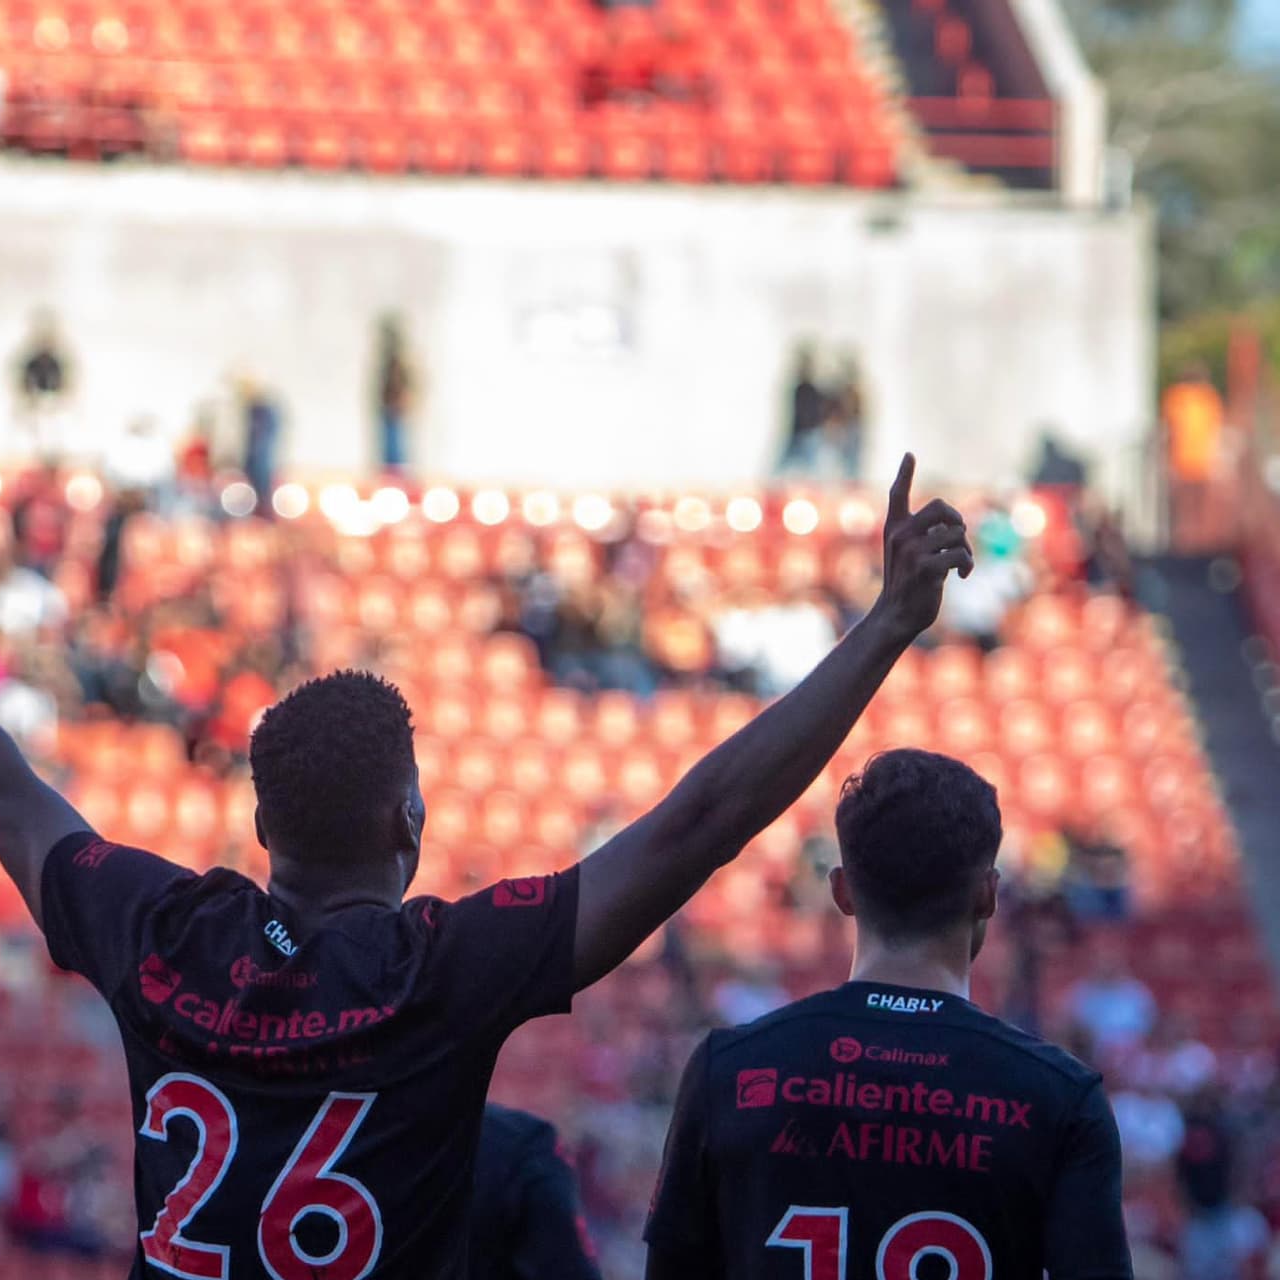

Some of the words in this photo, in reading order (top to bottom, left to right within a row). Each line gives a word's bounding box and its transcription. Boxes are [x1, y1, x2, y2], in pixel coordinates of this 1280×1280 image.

[867, 993, 944, 1013] CHARLY
[864, 1045, 951, 1067] Calimax
[781, 1072, 1033, 1130] caliente.mx
[825, 1121, 994, 1174] AFIRME
